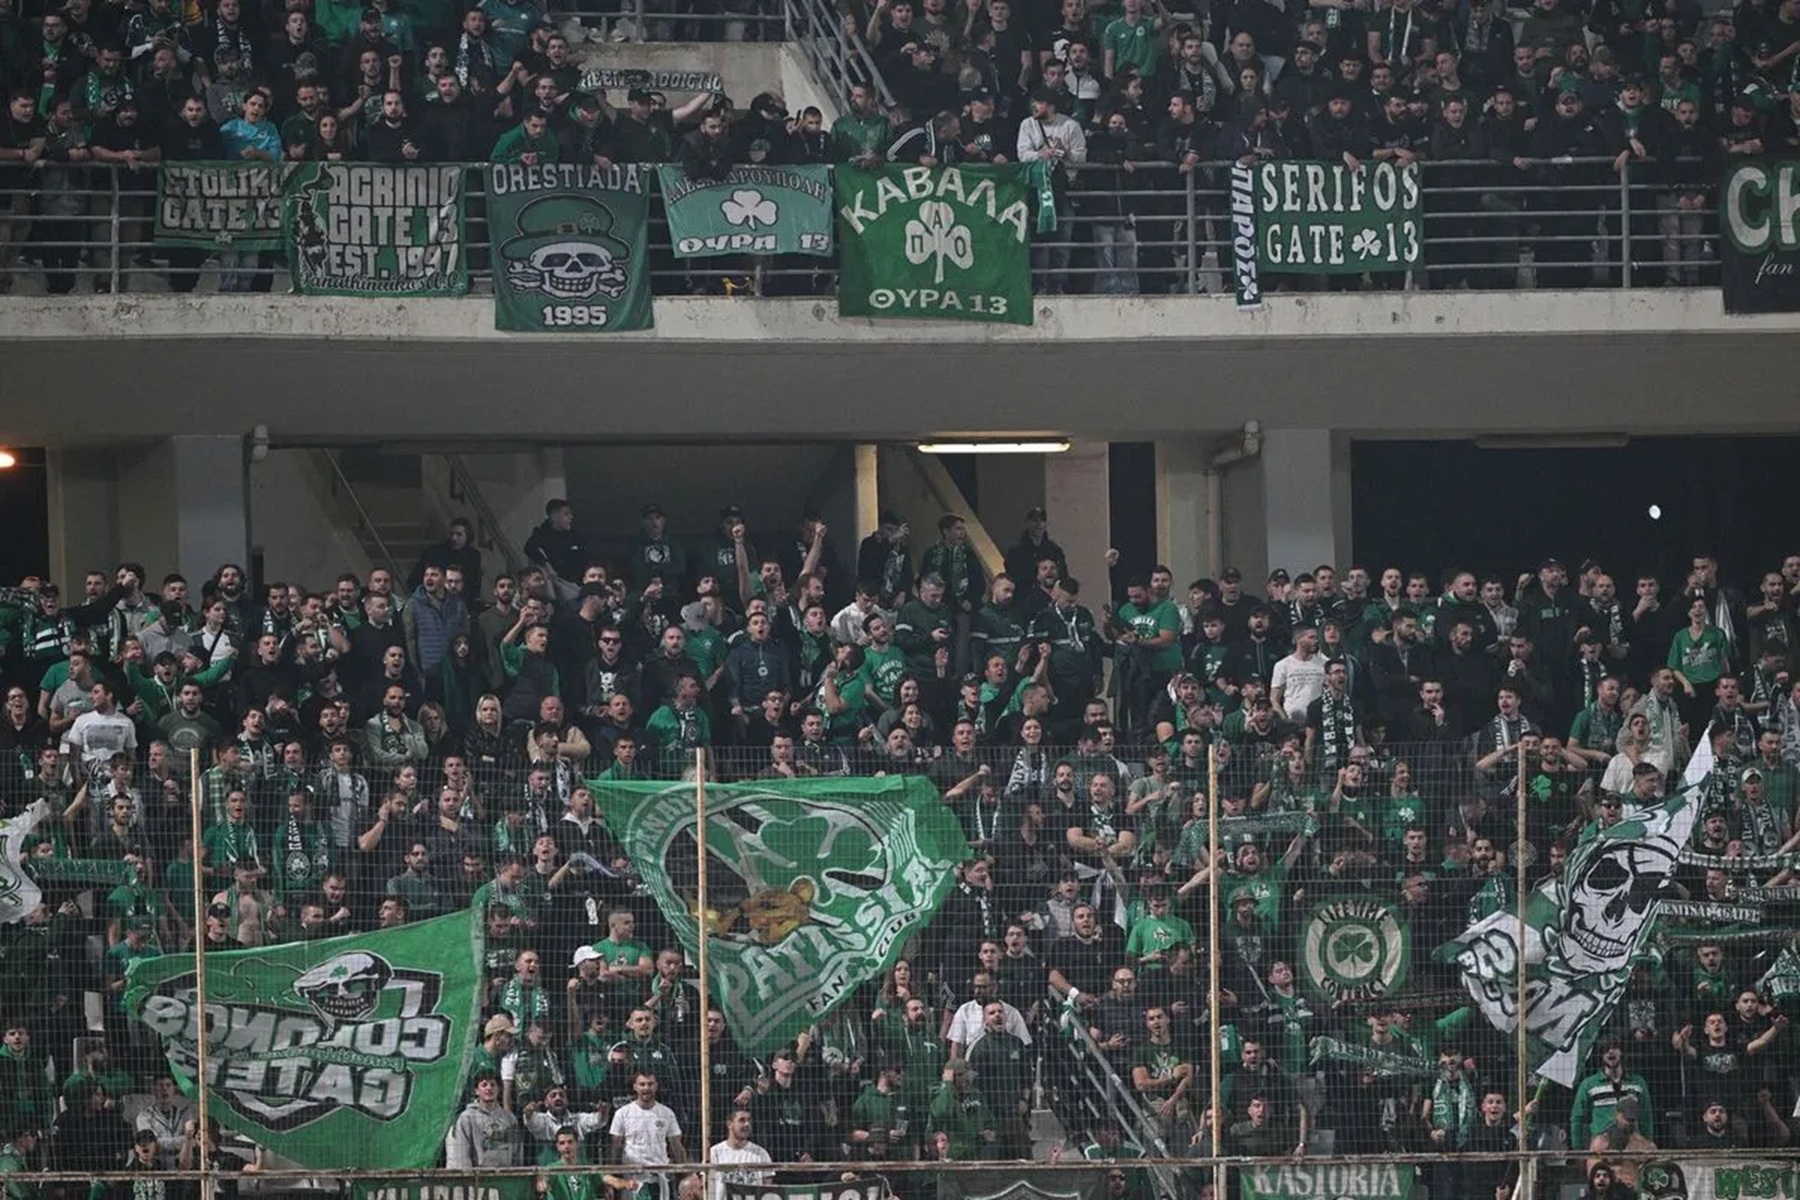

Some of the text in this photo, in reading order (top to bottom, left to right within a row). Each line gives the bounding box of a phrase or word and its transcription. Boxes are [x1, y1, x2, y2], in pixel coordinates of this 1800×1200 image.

[329, 166, 460, 206] AGRINIO
[493, 163, 642, 195] ORESTIADA
[1261, 162, 1419, 212] SERIFOS
[163, 199, 247, 230] GATE
[840, 166, 1028, 243] ΚΑΒΑΛΑ
[328, 203, 459, 246] GATE 13
[800, 234, 829, 251] 13
[1266, 220, 1419, 264] GATE 13
[328, 243, 389, 279] EST.
[1753, 252, 1794, 285] fan
[543, 305, 607, 326] 1995
[868, 288, 1008, 315] ΘΥΡΑ 13
[38, 859, 116, 874] KAVAL
[878, 911, 916, 958] CLUB
[805, 974, 847, 1012] FAN
